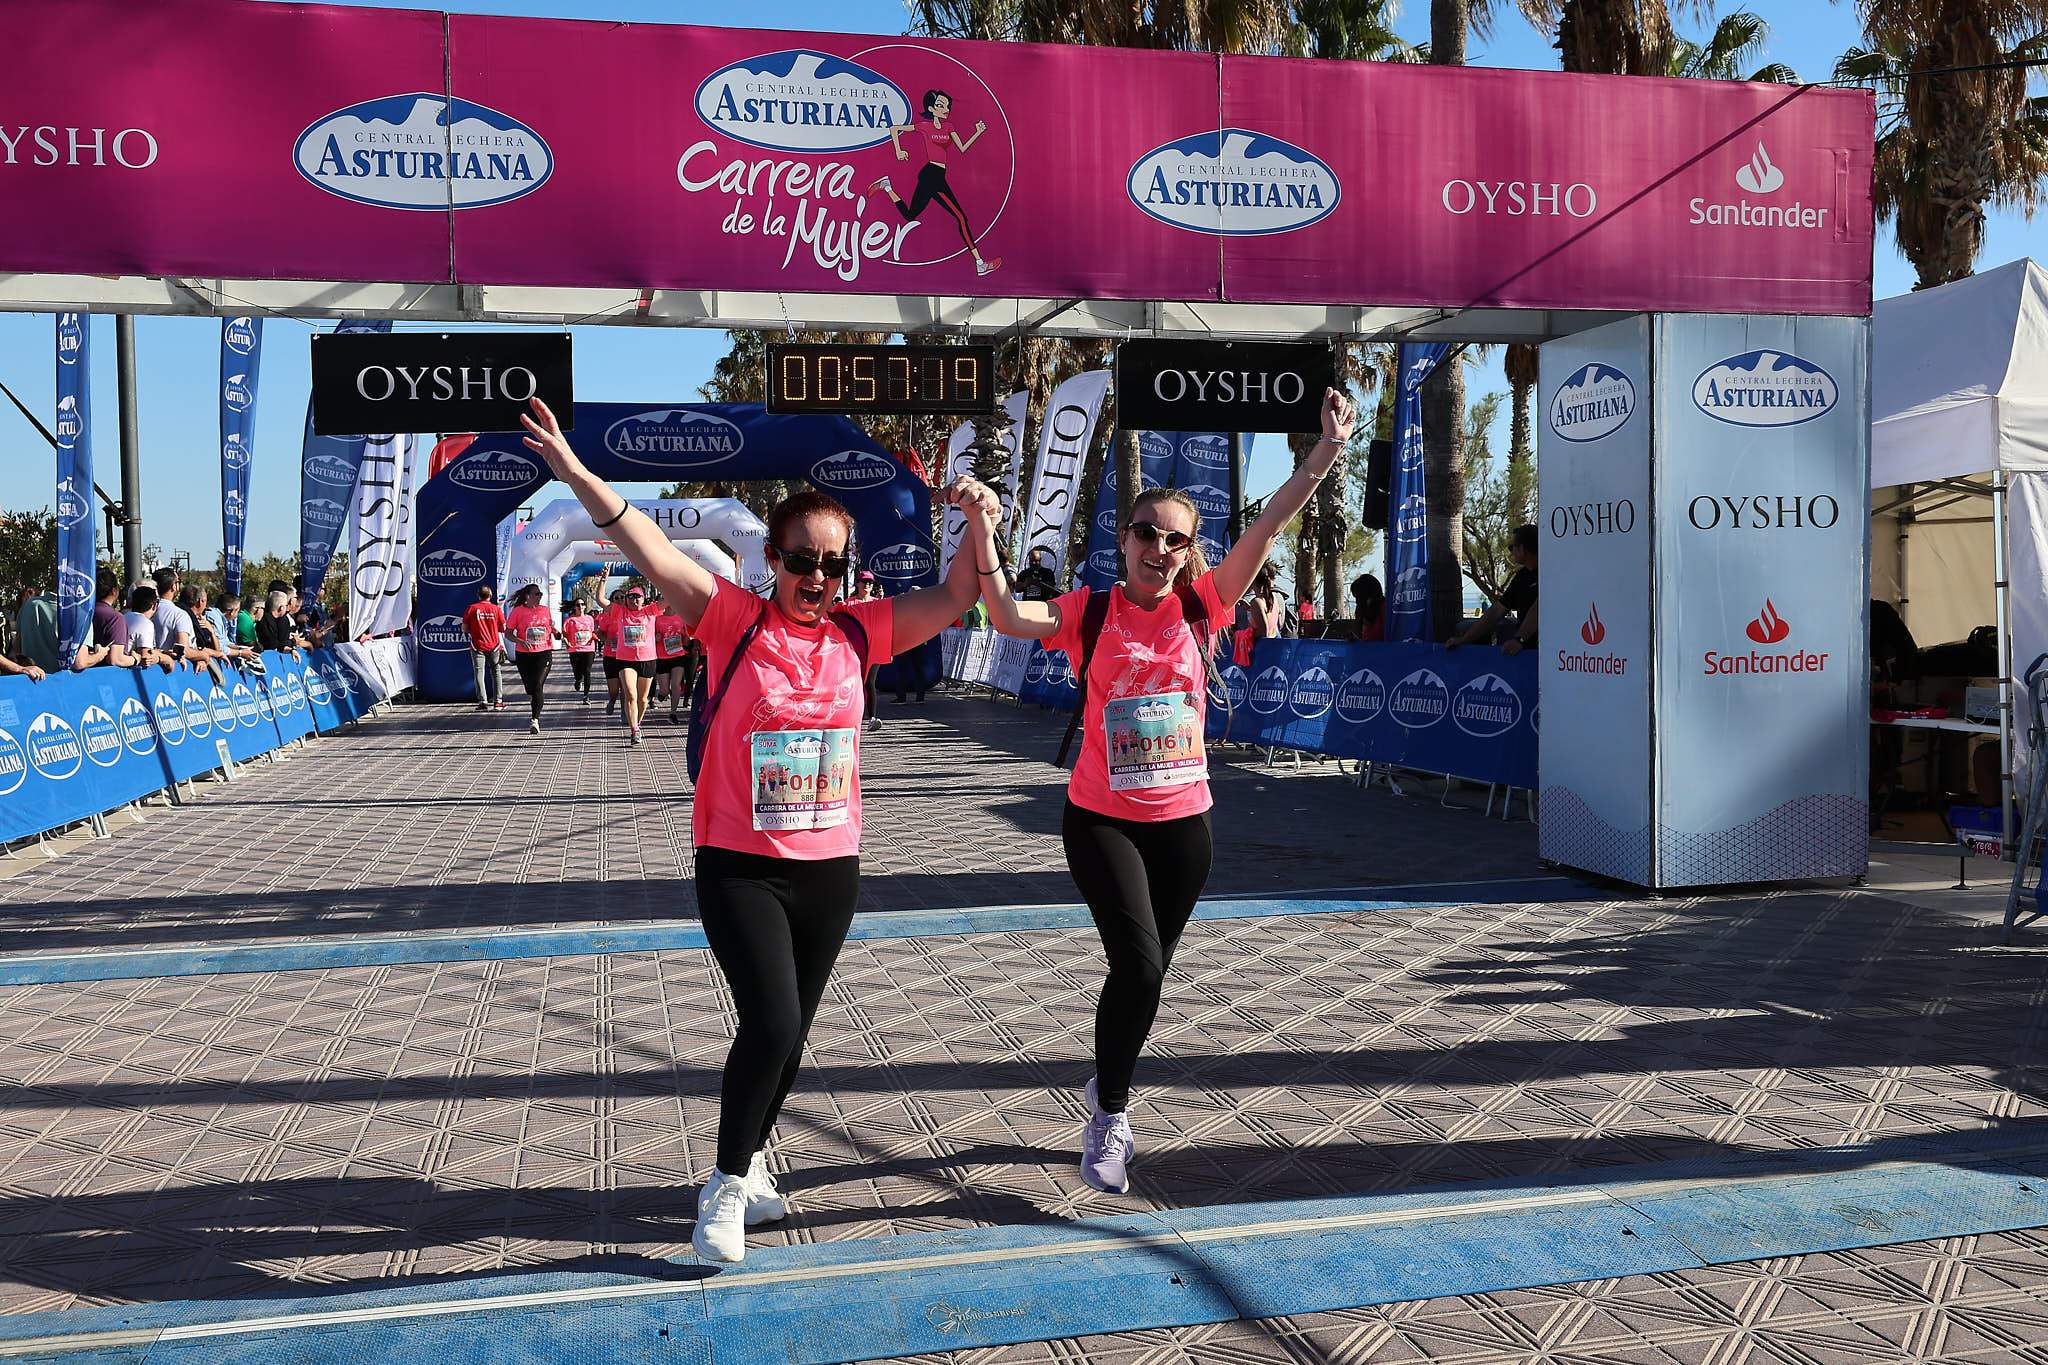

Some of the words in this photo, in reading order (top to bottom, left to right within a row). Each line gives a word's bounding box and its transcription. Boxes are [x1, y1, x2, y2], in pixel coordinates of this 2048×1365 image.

[746, 83, 814, 96] CENTRAL
[821, 86, 888, 99] LECHERA
[712, 83, 894, 129] ASTURIANA
[0, 126, 158, 168] YSHO
[354, 132, 435, 145] CENTRAL
[314, 133, 534, 181] ASTURIANA
[677, 140, 856, 200] Carrera
[1177, 164, 1244, 176] CENTRAL
[1250, 167, 1318, 179] LECHERA
[1144, 165, 1325, 209] ASTURIANA
[1442, 178, 1598, 218] OYSHO
[1689, 197, 1828, 230] Santander
[722, 198, 756, 235] de
[763, 198, 786, 236] la
[781, 196, 922, 282] Mujer
[356, 365, 538, 401] OYSHO
[783, 355, 977, 401] 00:57:19
[1154, 368, 1305, 405] OYSHO
[1725, 377, 1772, 385] CENTRAL
[1775, 377, 1823, 385] LECHERA
[1566, 391, 1593, 403] CENTRAL
[1595, 384, 1626, 397] LECHERA
[1702, 378, 1828, 408] ASTURIANA
[1555, 394, 1629, 427] ASTURIANA
[615, 427, 734, 452] ASTURIANA
[1186, 443, 1229, 463] ASTURIA
[454, 466, 531, 481] ASTURIANA
[819, 467, 892, 480] ASTURIANA
[303, 505, 342, 524] ASTURIA
[354, 434, 396, 600] OYSH
[1551, 499, 1635, 539] OYSHO
[1688, 494, 1839, 530] OYSHO
[525, 532, 560, 540] OYSHO
[422, 563, 482, 577] ASTURIANA
[873, 558, 930, 572] ASTURIANA
[511, 577, 543, 585] OYSHO
[1558, 649, 1628, 676] Santander
[1704, 649, 1829, 675] Santander
[1253, 687, 1285, 703] ASTURIANA
[1291, 683, 1330, 706] ASTURIANA
[1338, 688, 1380, 710] ASTURIANA
[1392, 690, 1443, 715] ASTURIANA
[1136, 709, 1174, 719] ASTURIANA
[1456, 694, 1513, 724] ASTURIANA
[84, 729, 121, 754] ASTURIANA
[123, 720, 156, 744] ASTURIANA
[1140, 734, 1177, 752] 016
[32, 740, 81, 767] ASTURIANA
[787, 744, 828, 754] ASTURIANA
[1151, 754, 1165, 762] 891
[1114, 764, 1140, 774] CARRERA
[1120, 775, 1153, 784] OYSHO
[789, 774, 829, 791] 016
[759, 804, 787, 812] CARRERA
[787, 803, 796, 811] DE
[801, 794, 814, 802] 888
[765, 816, 800, 825] OYSHO
